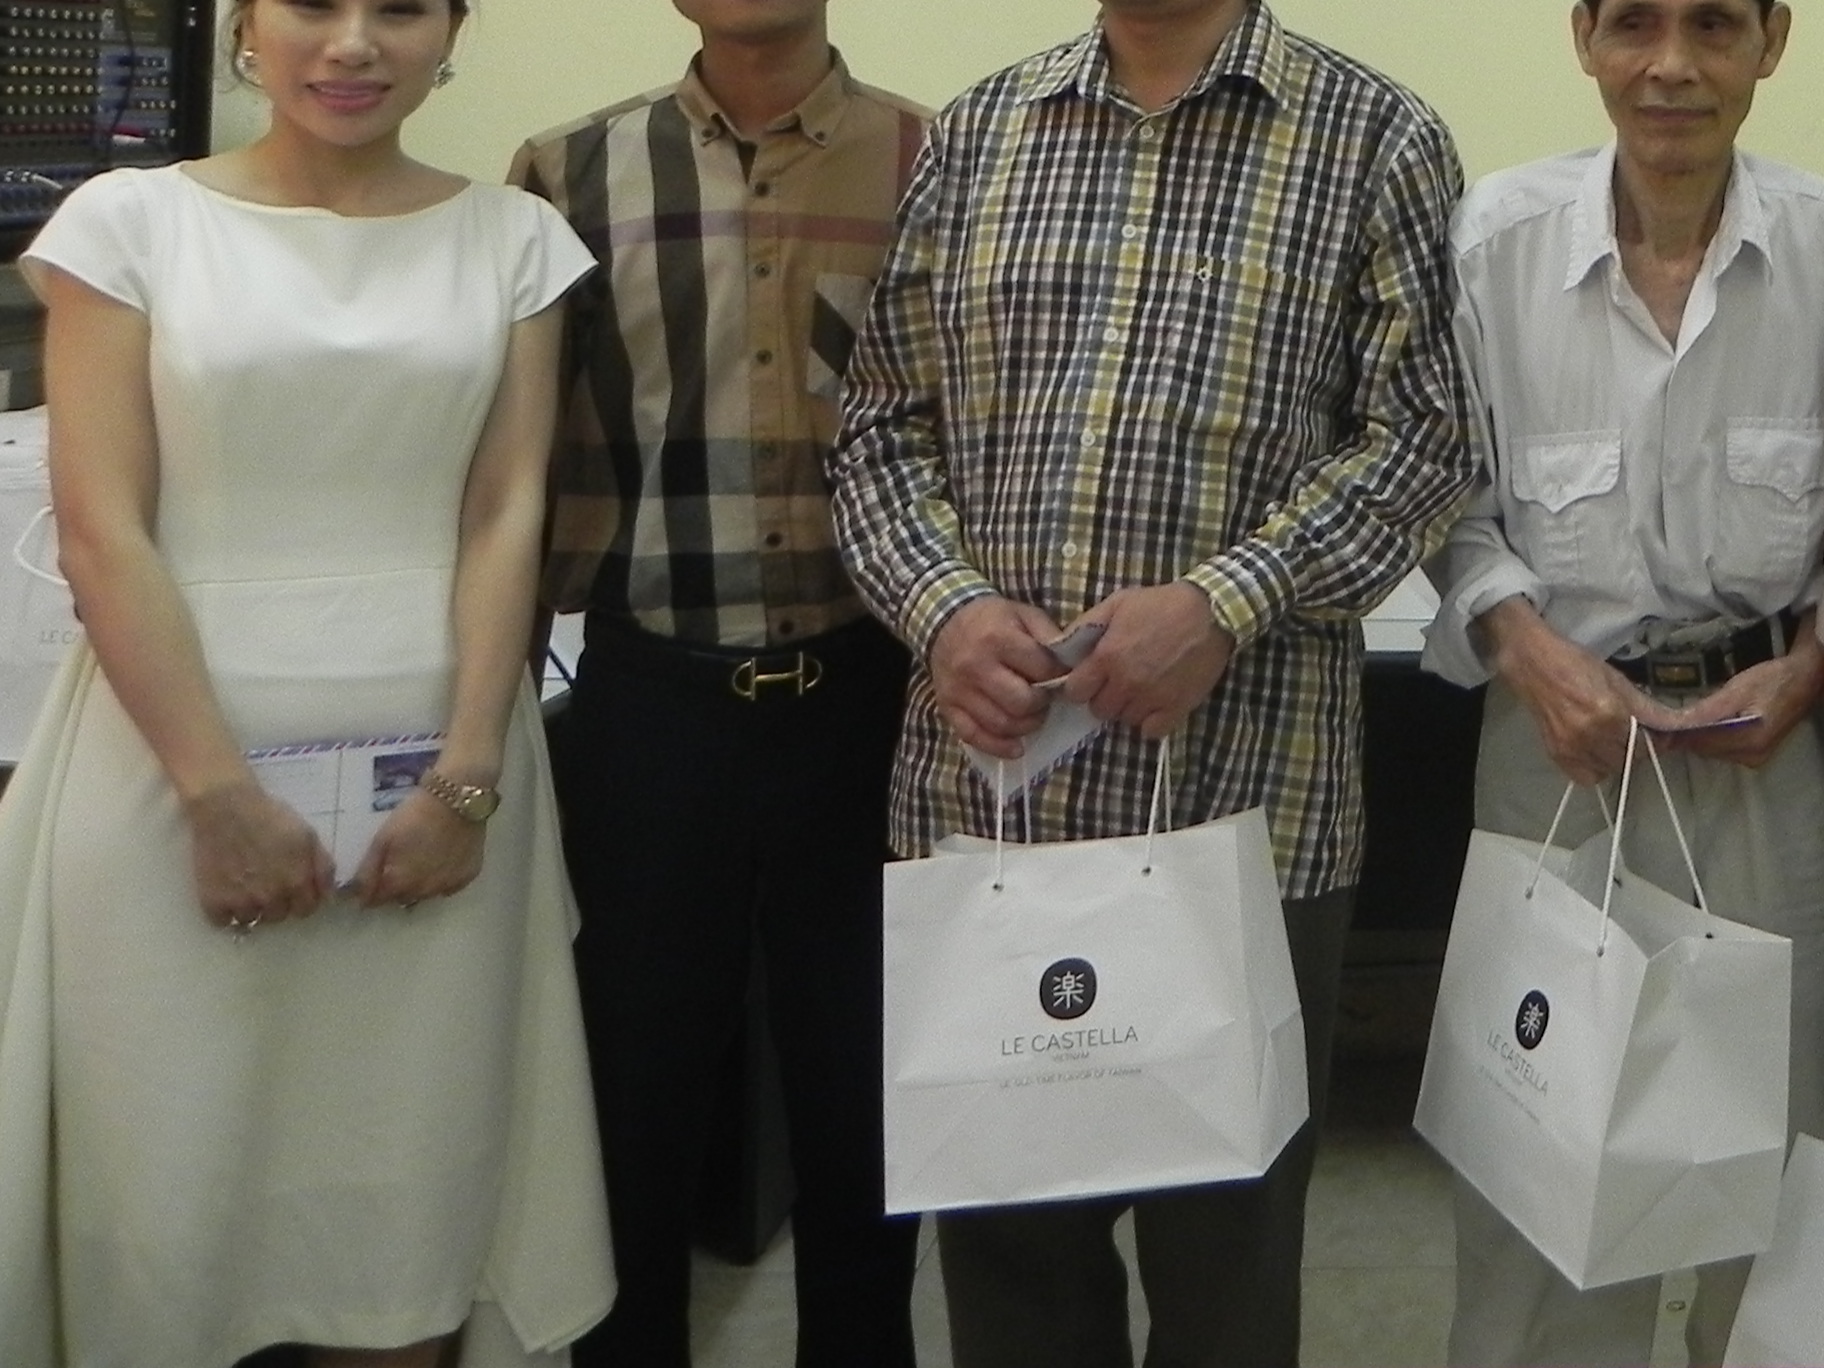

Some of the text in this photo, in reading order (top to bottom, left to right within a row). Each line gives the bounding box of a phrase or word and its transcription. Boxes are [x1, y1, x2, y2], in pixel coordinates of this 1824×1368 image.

[1002, 1026, 1138, 1056] LE CASTELLA
[1500, 1042, 1549, 1097] CASTELLA
